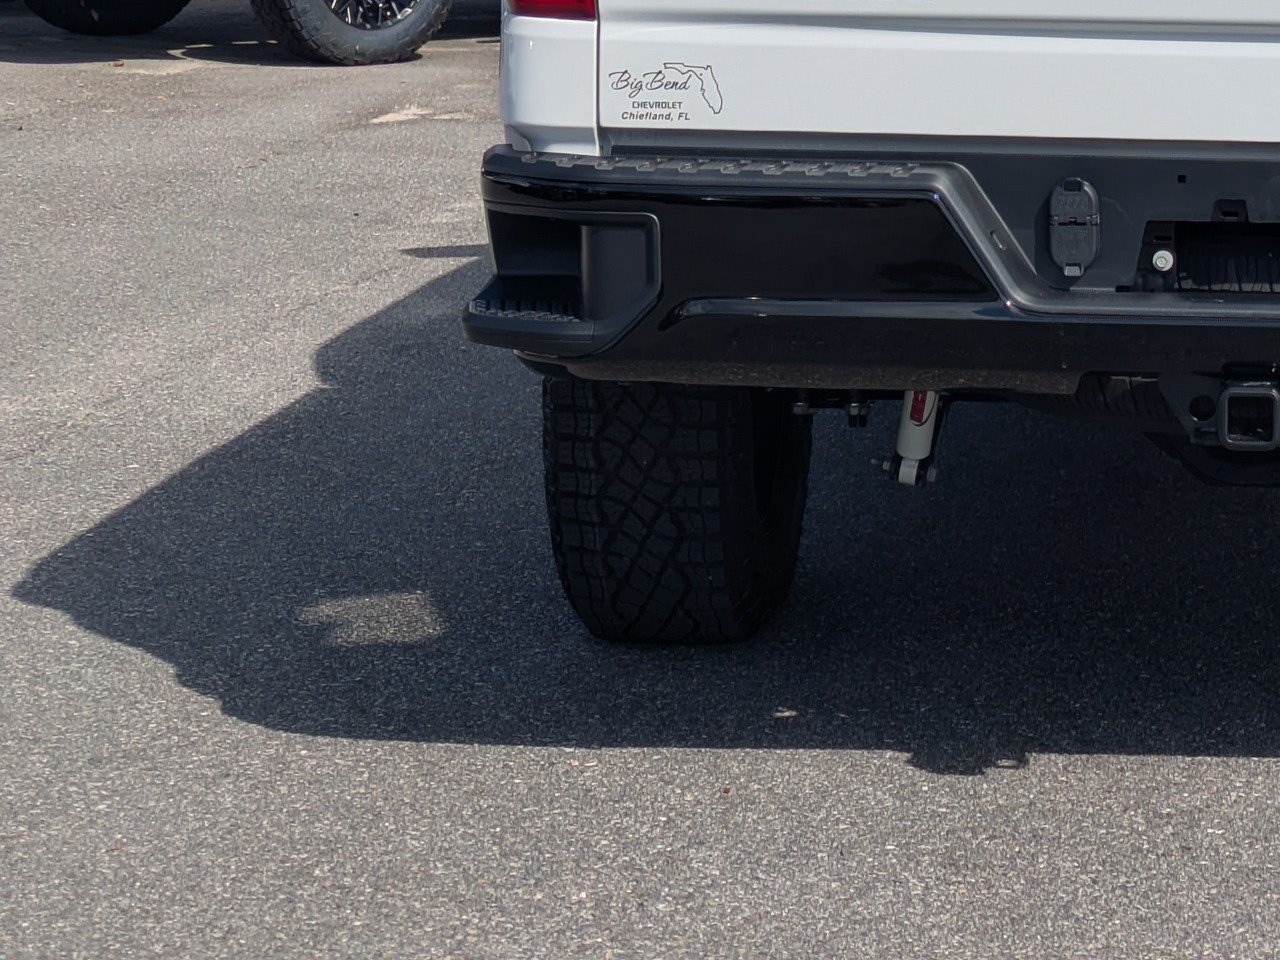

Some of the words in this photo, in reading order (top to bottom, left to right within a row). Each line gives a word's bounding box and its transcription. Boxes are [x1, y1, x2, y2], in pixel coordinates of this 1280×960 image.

[608, 69, 644, 99] Big
[643, 69, 693, 91] Bend
[631, 100, 684, 110] CHEVROLET
[621, 111, 675, 122] Chiefland,
[677, 112, 691, 121] FL
